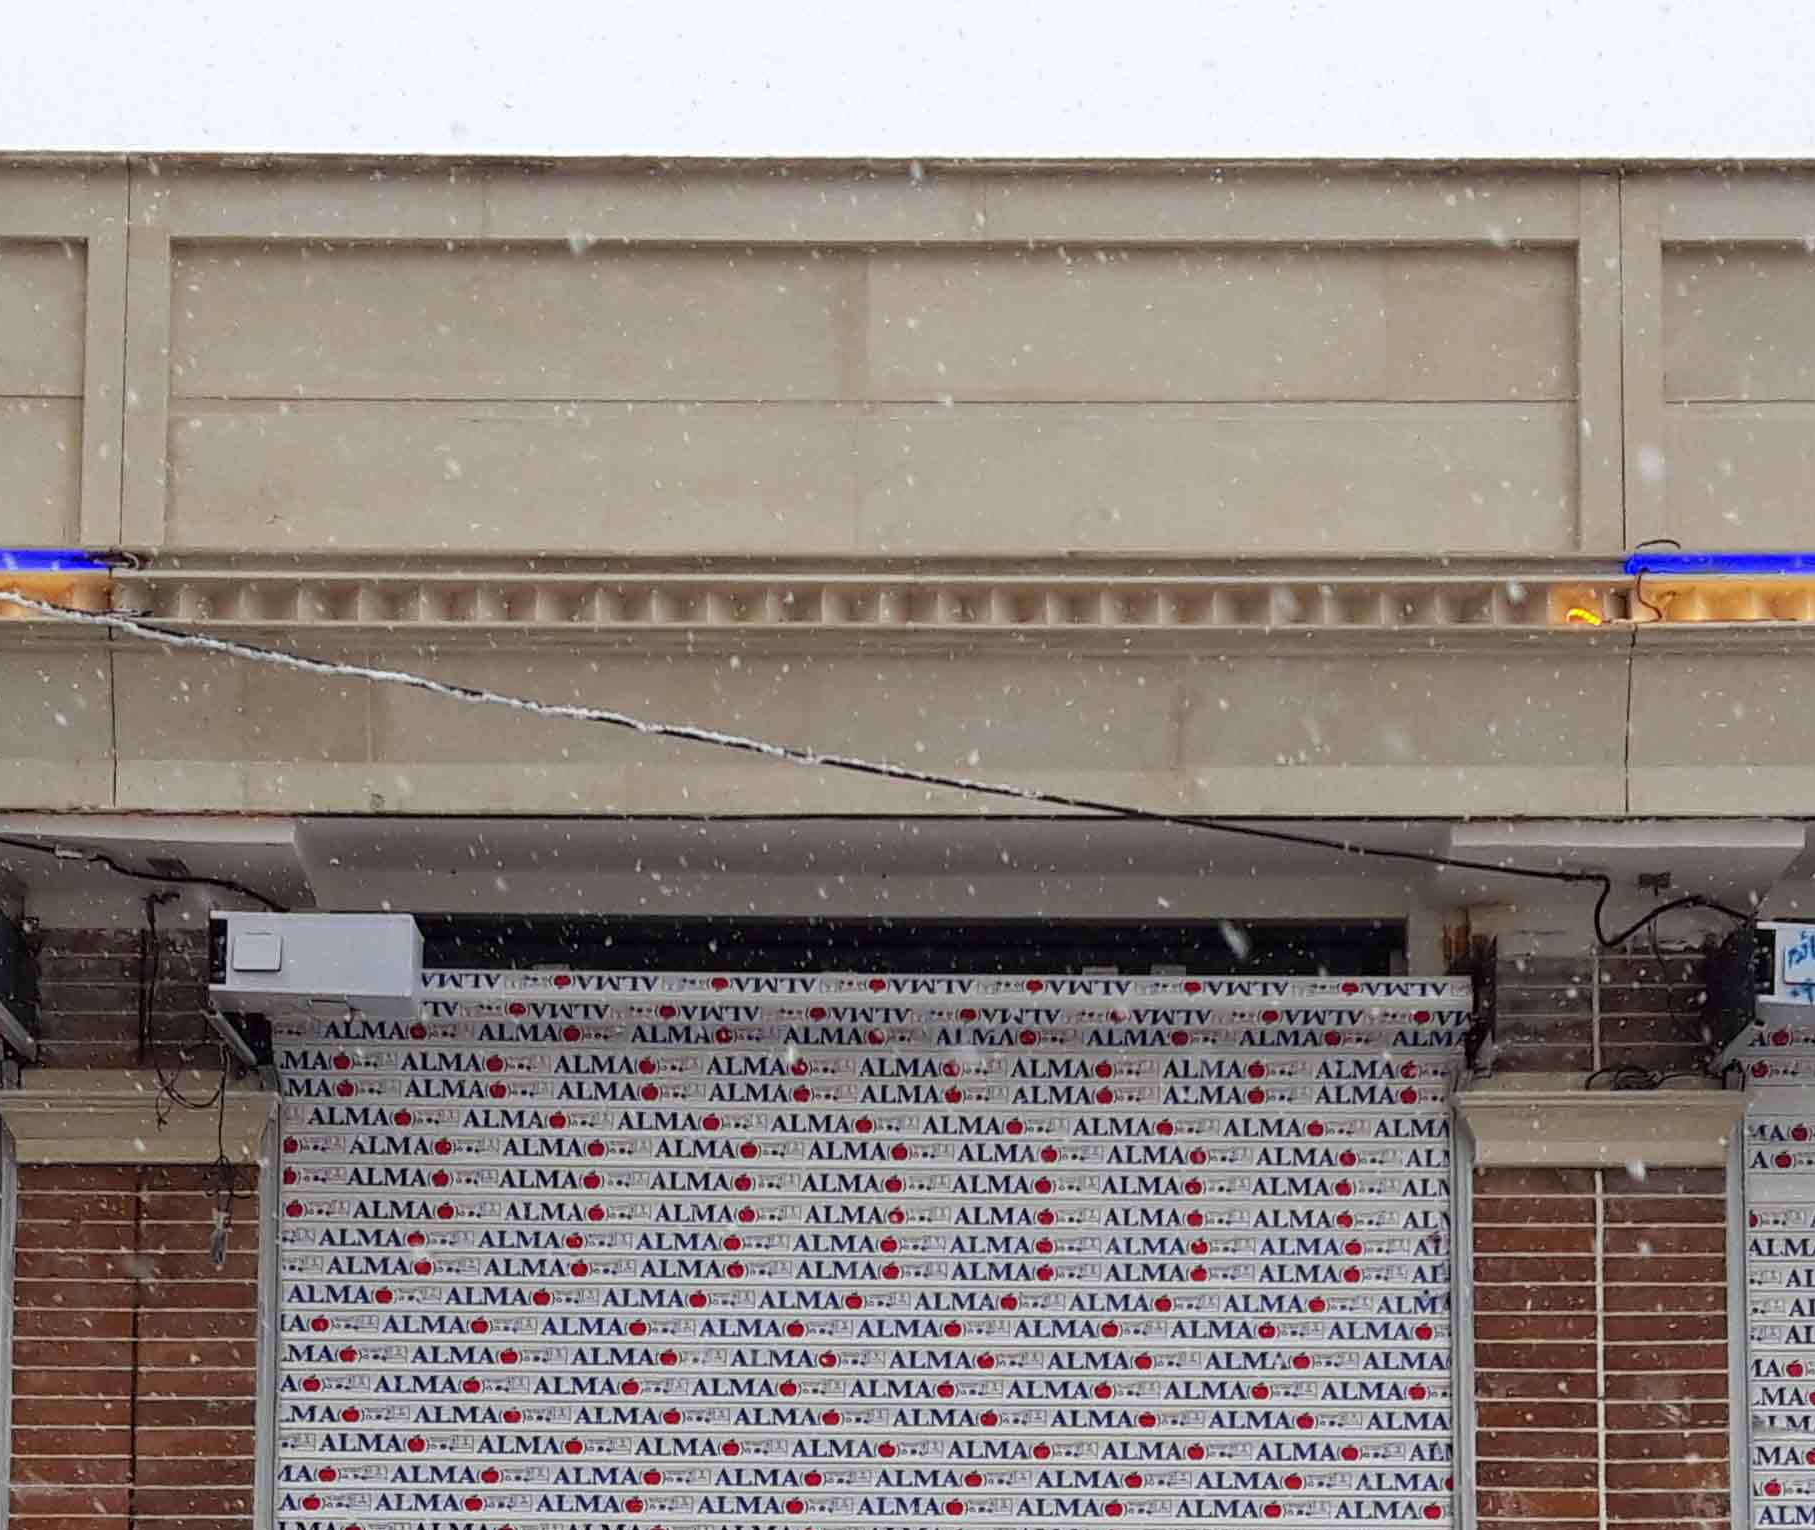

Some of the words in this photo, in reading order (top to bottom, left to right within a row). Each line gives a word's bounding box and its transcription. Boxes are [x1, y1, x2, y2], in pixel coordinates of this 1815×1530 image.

[404, 1078, 485, 1099] ALMA
[557, 1081, 637, 1101] ALMA
[708, 1082, 788, 1103] ALMA
[860, 1084, 940, 1104] ALMA
[1012, 1085, 1092, 1105] ALMA
[1162, 1085, 1242, 1105] ALMA
[1315, 1085, 1396, 1105] ALMA
[382, 1314, 467, 1334] ALMA
[540, 1316, 624, 1336] ALMA
[699, 1318, 782, 1338] ALMA
[856, 1319, 940, 1338] ALMA
[1014, 1319, 1099, 1338] ALMA
[1169, 1319, 1253, 1340] ALMA
[1327, 1321, 1411, 1341] ALMA
